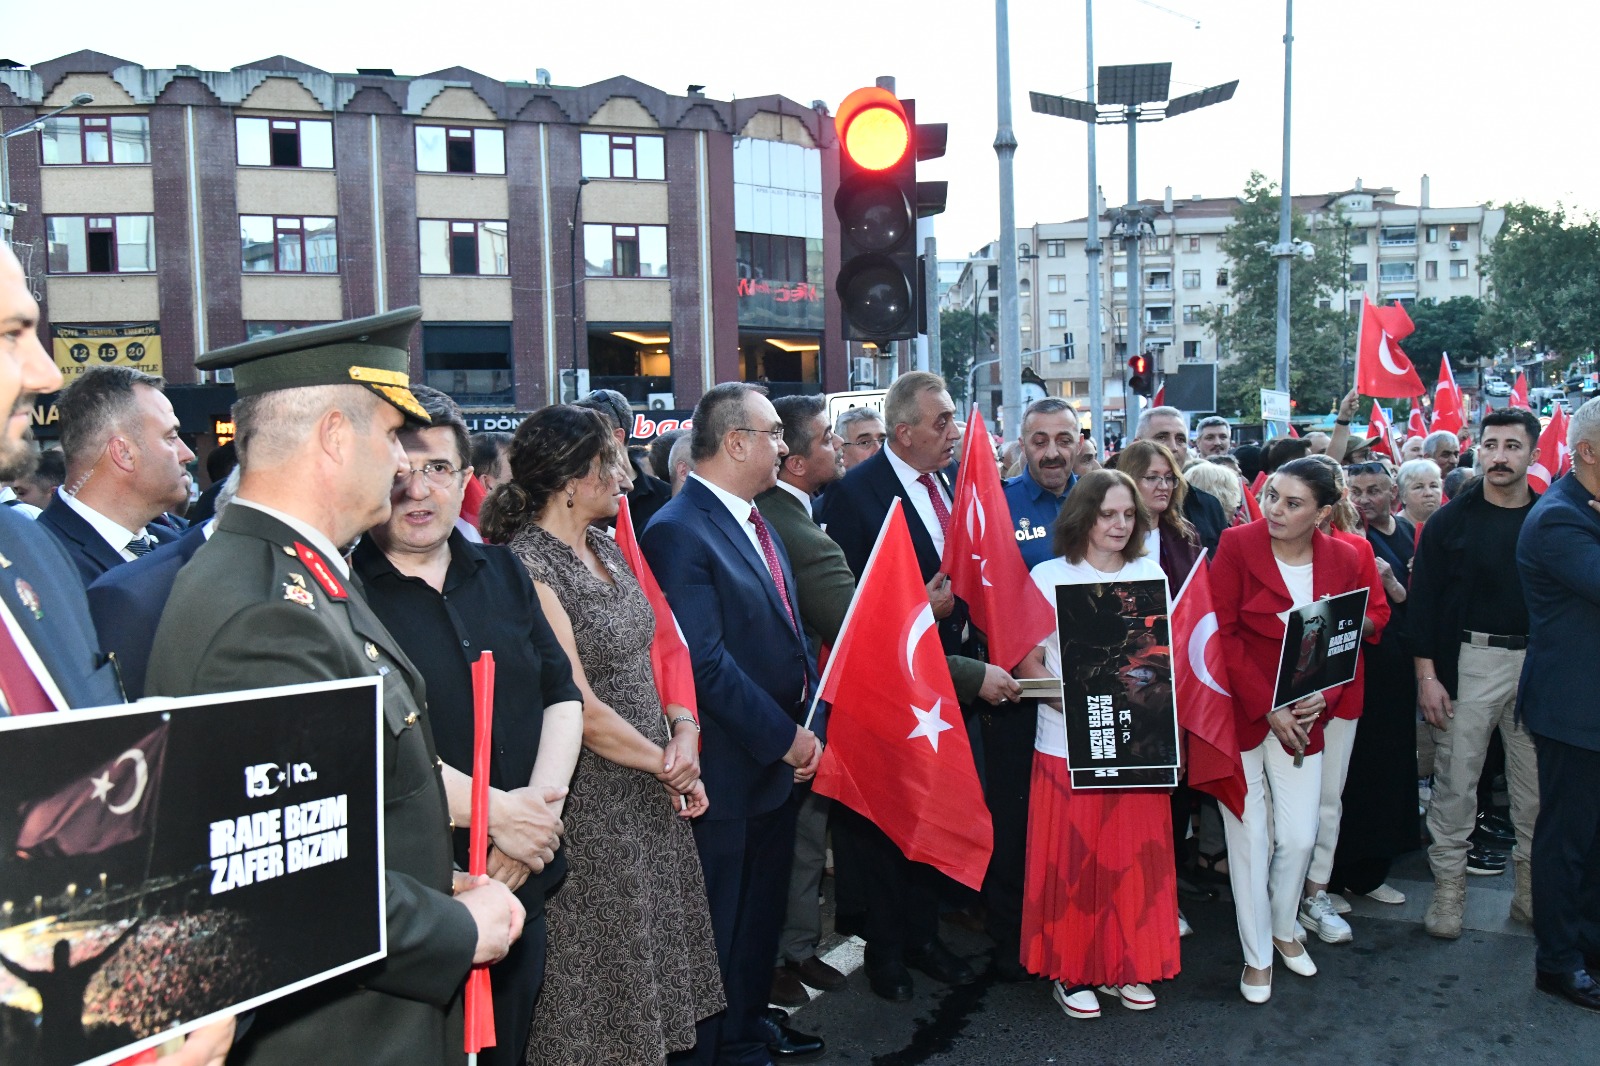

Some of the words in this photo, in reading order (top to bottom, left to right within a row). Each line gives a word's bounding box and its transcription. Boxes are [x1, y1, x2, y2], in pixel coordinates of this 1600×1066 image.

[73, 348, 88, 358] 12
[101, 347, 116, 358] 15
[128, 347, 144, 357] 20
[484, 415, 526, 431] DÖN
[1087, 696, 1100, 727] ZAFER
[284, 793, 348, 840] BİZİM
[210, 843, 284, 895] ZAFER
[286, 827, 348, 874] BİZİM
